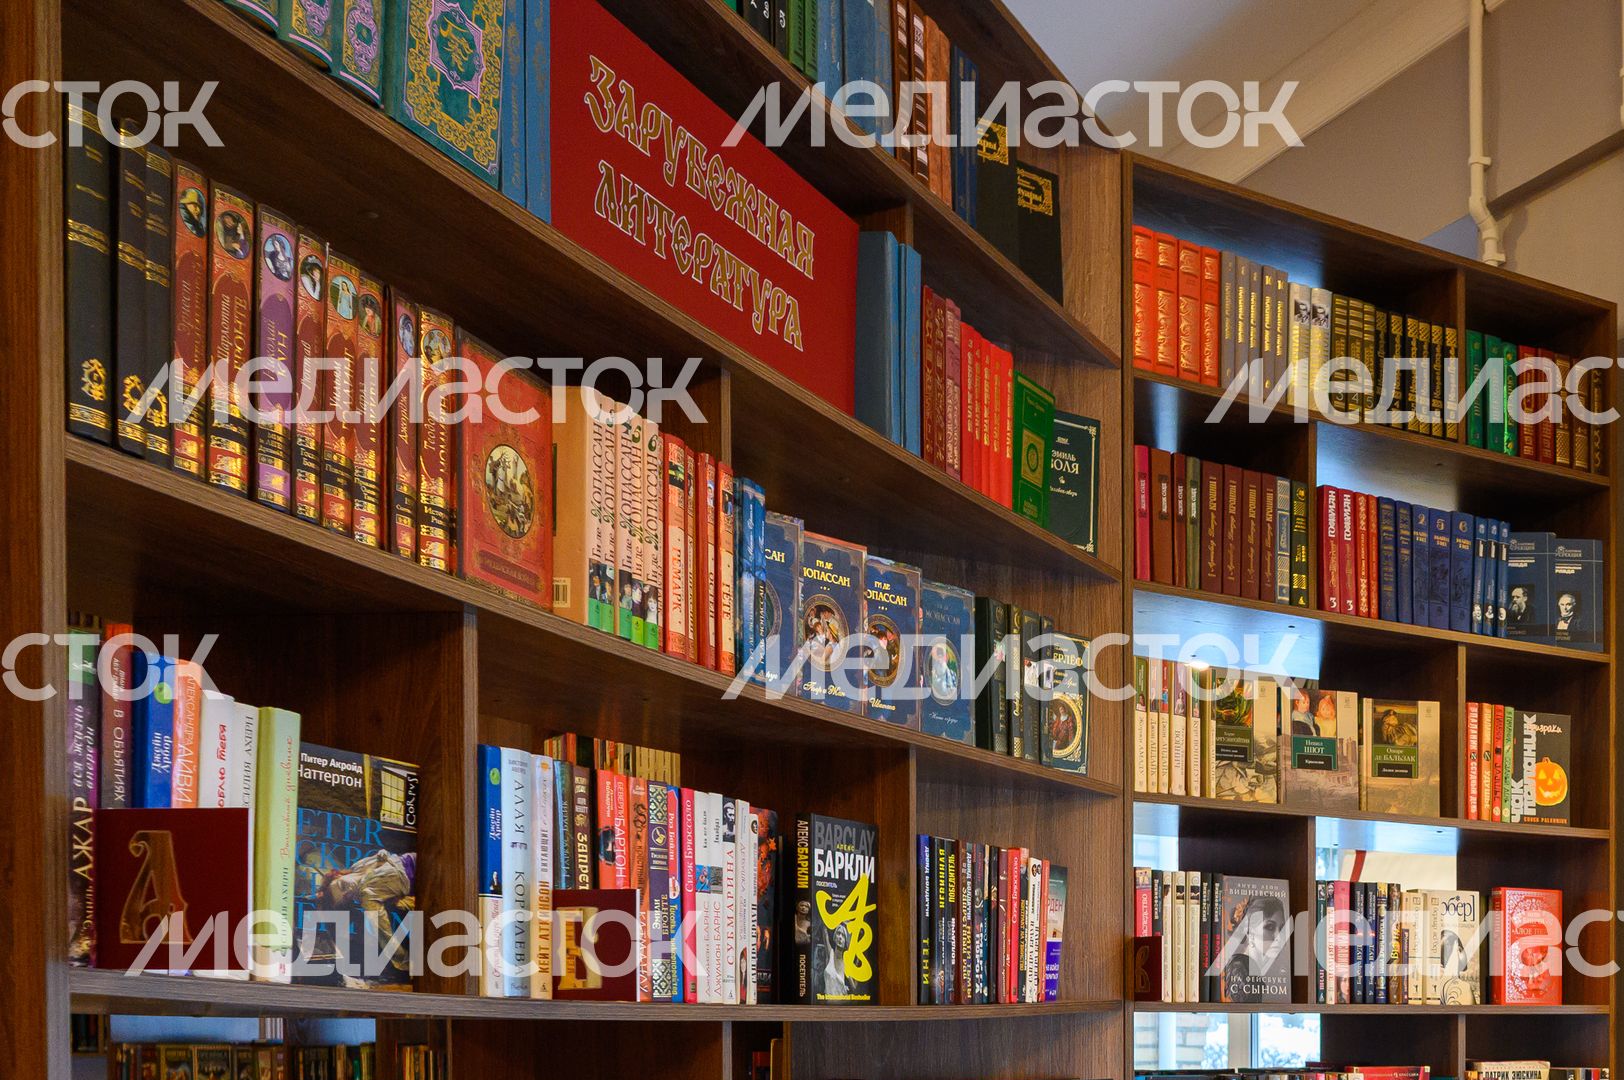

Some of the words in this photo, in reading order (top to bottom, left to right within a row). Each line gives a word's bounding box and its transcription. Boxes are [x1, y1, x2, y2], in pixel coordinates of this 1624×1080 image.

[584, 54, 816, 281] ЗАРУБЕЖНАЯ
[593, 159, 804, 353] ЛИТЕРАТУРА
[591, 422, 604, 524] МОПАССАН
[647, 434, 659, 452] 6
[603, 427, 615, 530] МОПАССАН
[620, 435, 634, 535] МОПАССАН
[631, 447, 645, 544] МОПАССАН
[645, 453, 660, 551] МОПАССАН
[671, 547, 682, 612] РЕМАРК
[176, 743, 195, 804] АЙВИ
[300, 752, 328, 768] Питер
[329, 758, 363, 775] Акройд
[72, 796, 95, 881] АЖАР
[513, 780, 526, 835] АЛАЯ
[815, 820, 876, 857] BARCLAY
[614, 816, 626, 878] БАРТОН
[797, 847, 809, 889] БАРКЛИ
[813, 847, 876, 884] БАРКЛИ
[119, 829, 194, 945] А
[537, 879, 550, 941] АТКИНСОН
[726, 849, 736, 966] СУБМАРИНА
[513, 870, 526, 976] КОРОЛЕВА
[712, 900, 722, 942] БАРНС
[537, 943, 550, 974] КЕЙТ
[922, 937, 930, 985] ТЕНИ
[1230, 985, 1239, 994] С
[1243, 985, 1289, 995] СЫНОМ
